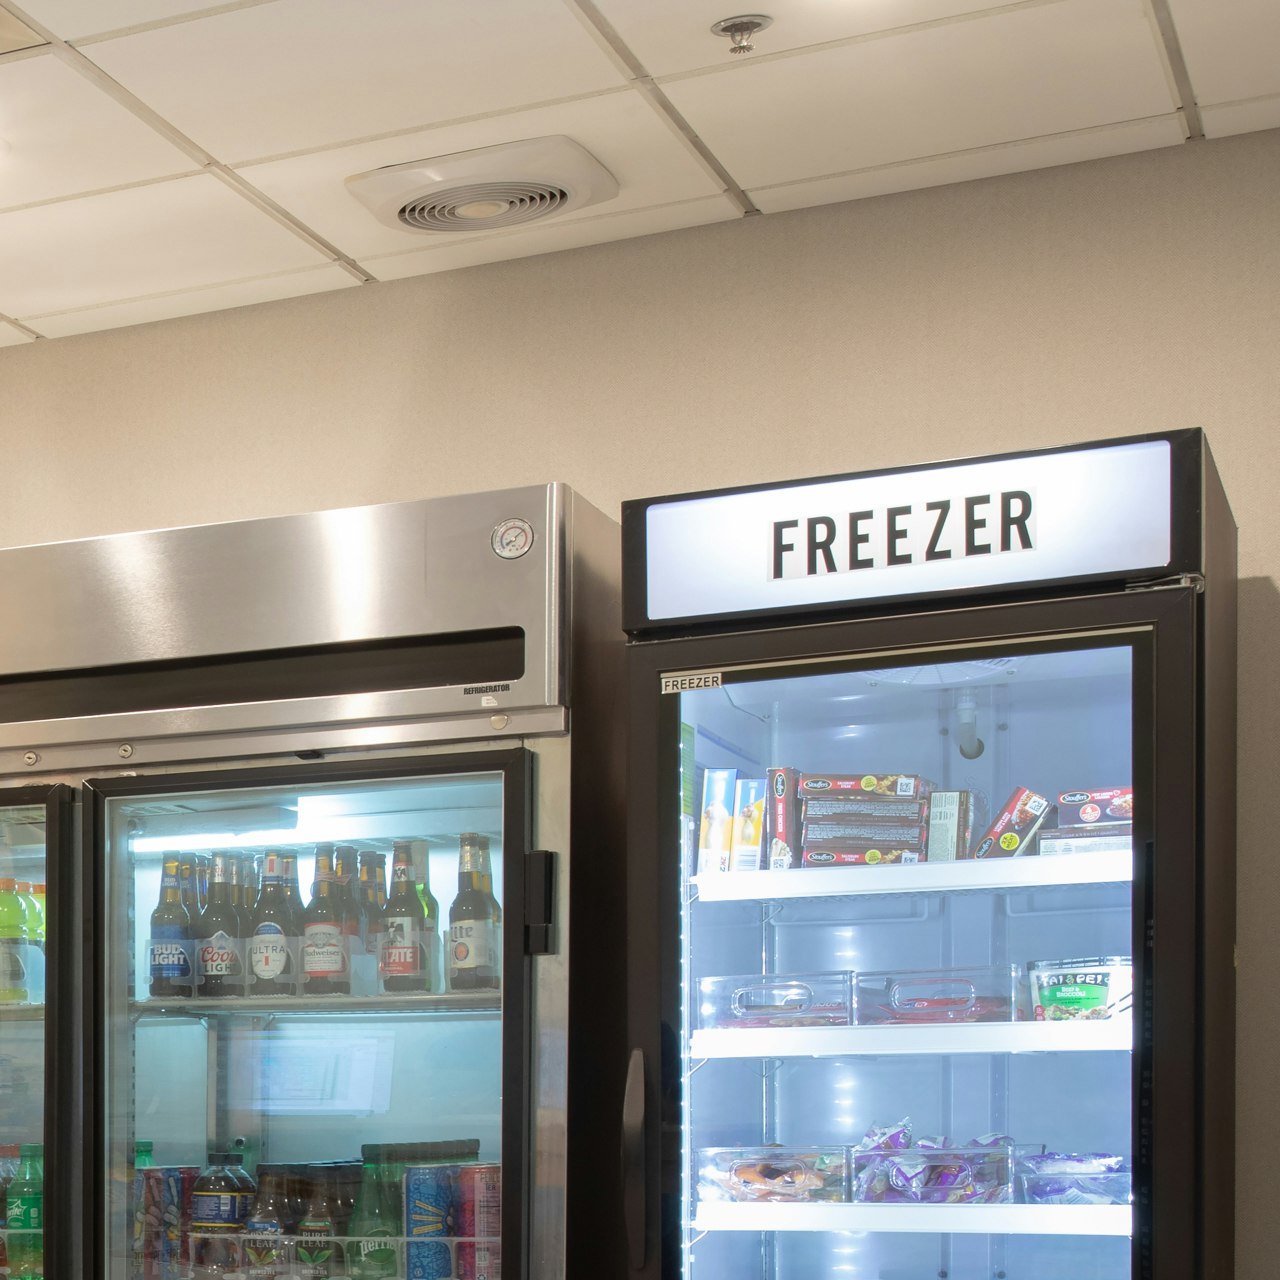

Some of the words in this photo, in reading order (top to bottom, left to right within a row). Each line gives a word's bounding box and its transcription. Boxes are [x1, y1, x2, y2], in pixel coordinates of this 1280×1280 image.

[773, 490, 1034, 581] FREEZER
[664, 675, 721, 691] FREEZER
[463, 684, 510, 695] REFRIGERATOR
[153, 944, 181, 955] BUD
[201, 945, 238, 963] Coor
[252, 945, 286, 954] ULTRA
[151, 954, 185, 966] LIGHT
